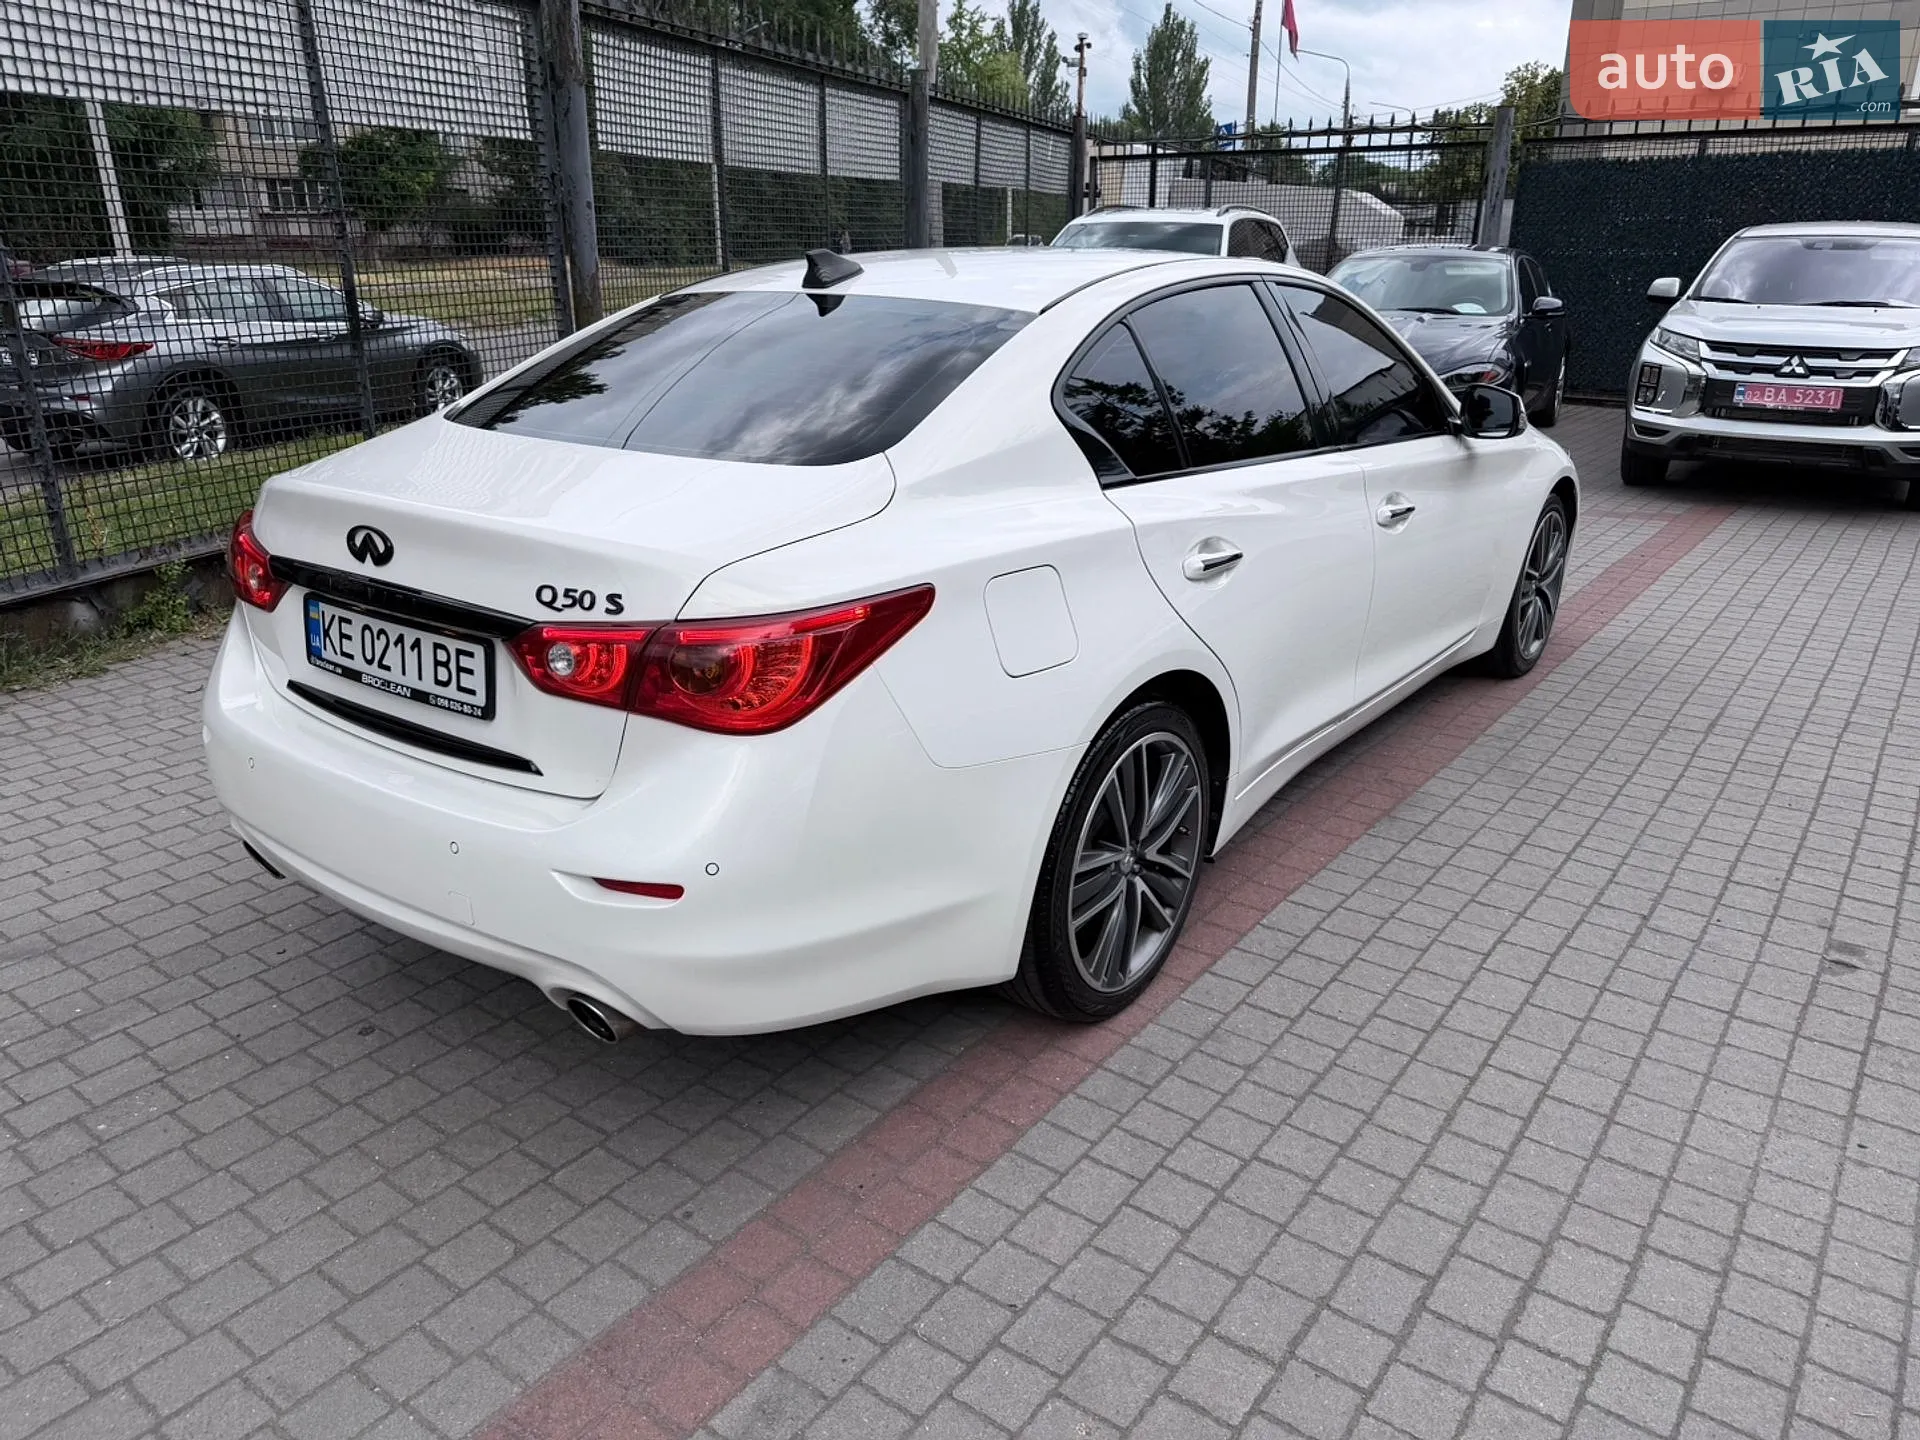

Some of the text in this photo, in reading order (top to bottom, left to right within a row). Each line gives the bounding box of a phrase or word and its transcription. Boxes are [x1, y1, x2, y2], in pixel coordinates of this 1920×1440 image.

[1764, 387, 1787, 403] BA
[1793, 389, 1836, 405] 5231
[535, 584, 624, 615] Q50 S
[310, 633, 321, 648] UA
[321, 610, 477, 696] KE 0211 BE
[361, 673, 411, 698] BROCLEAN
